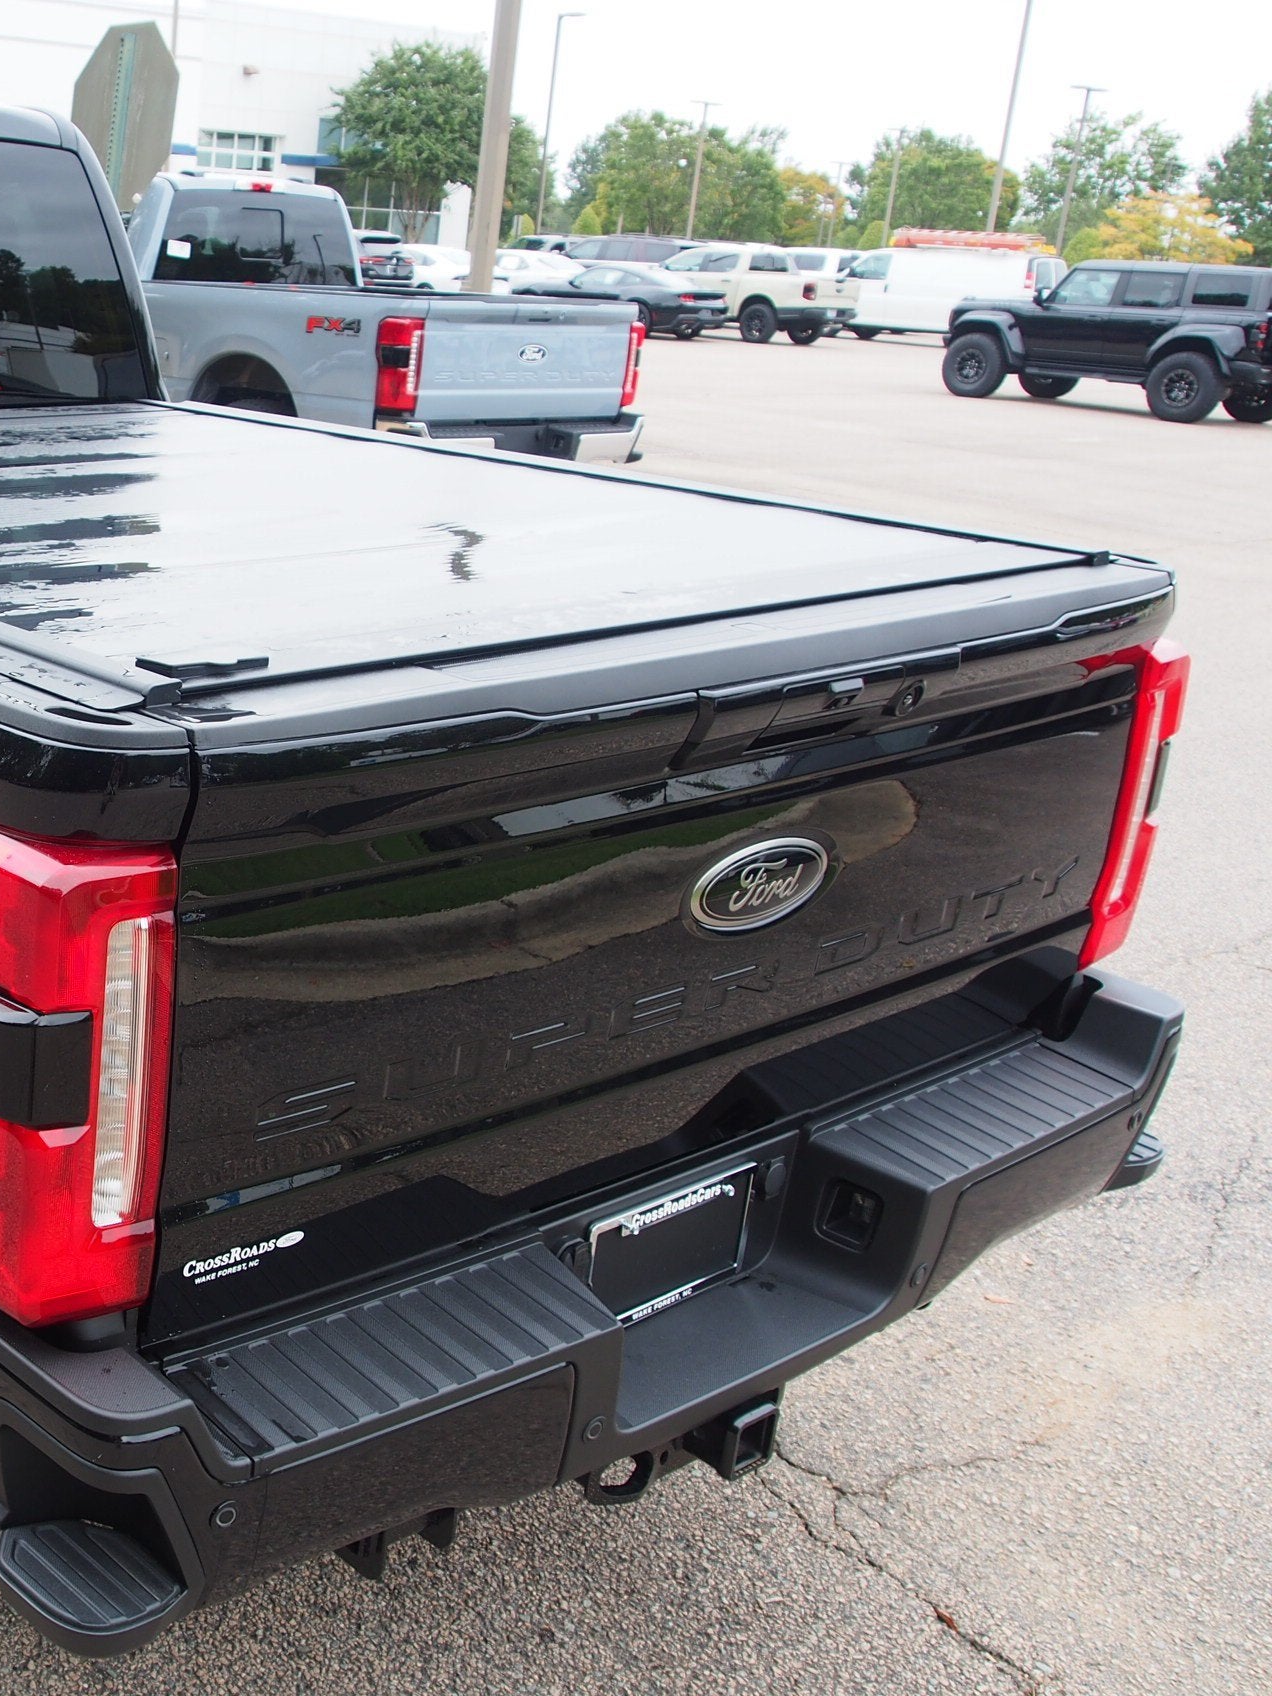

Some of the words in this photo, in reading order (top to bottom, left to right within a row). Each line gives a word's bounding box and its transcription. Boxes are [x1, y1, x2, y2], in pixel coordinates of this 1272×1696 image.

[306, 316, 361, 333] FX4
[728, 857, 804, 912] Ford
[252, 954, 781, 1143] SUPER
[813, 855, 1080, 976] DUTY
[631, 1184, 722, 1228] CrossRoadsCars
[194, 1272, 217, 1285] WAKE
[217, 1262, 248, 1278] FOREST,
[248, 1258, 260, 1268] NC
[631, 1305, 654, 1320] WAKE
[682, 1288, 693, 1299] NC
